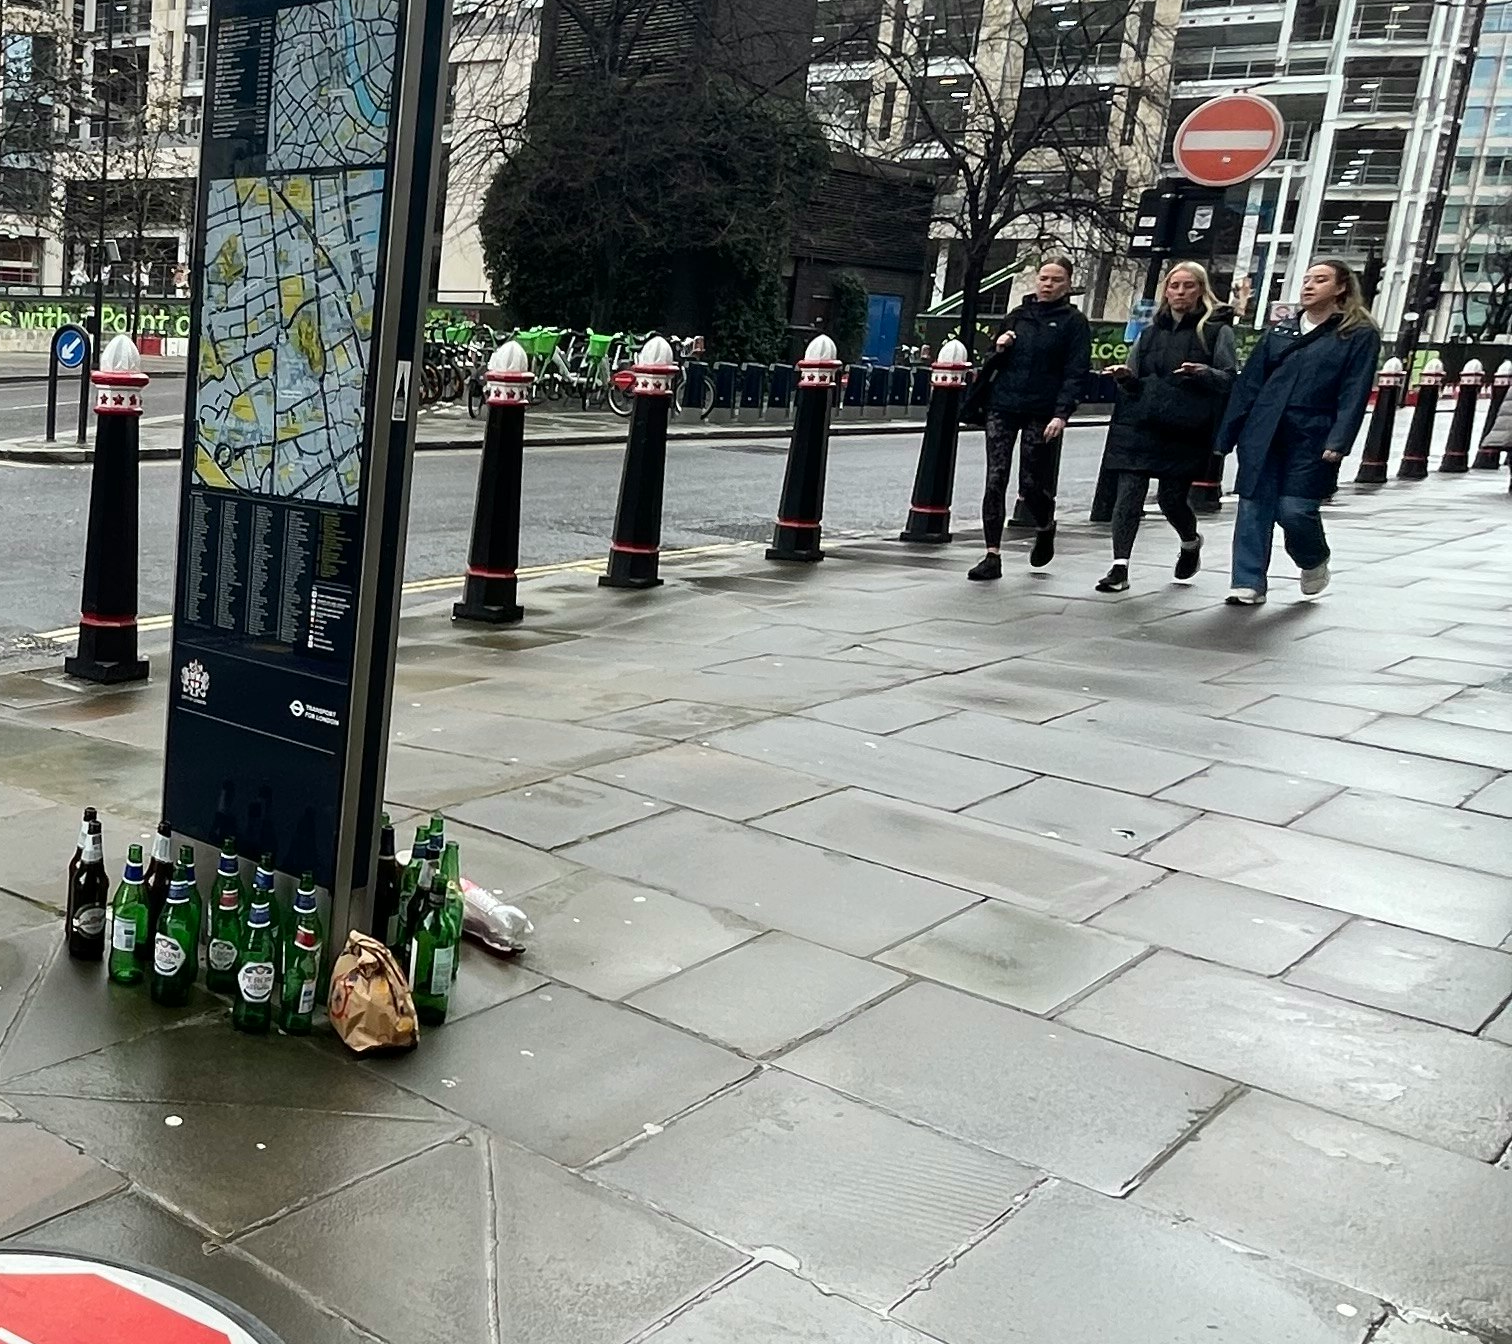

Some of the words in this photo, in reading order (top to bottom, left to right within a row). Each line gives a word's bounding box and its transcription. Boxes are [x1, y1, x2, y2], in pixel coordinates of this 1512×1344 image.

[18, 307, 71, 330] with
[101, 307, 170, 334] Pont
[1091, 338, 1130, 359] ice
